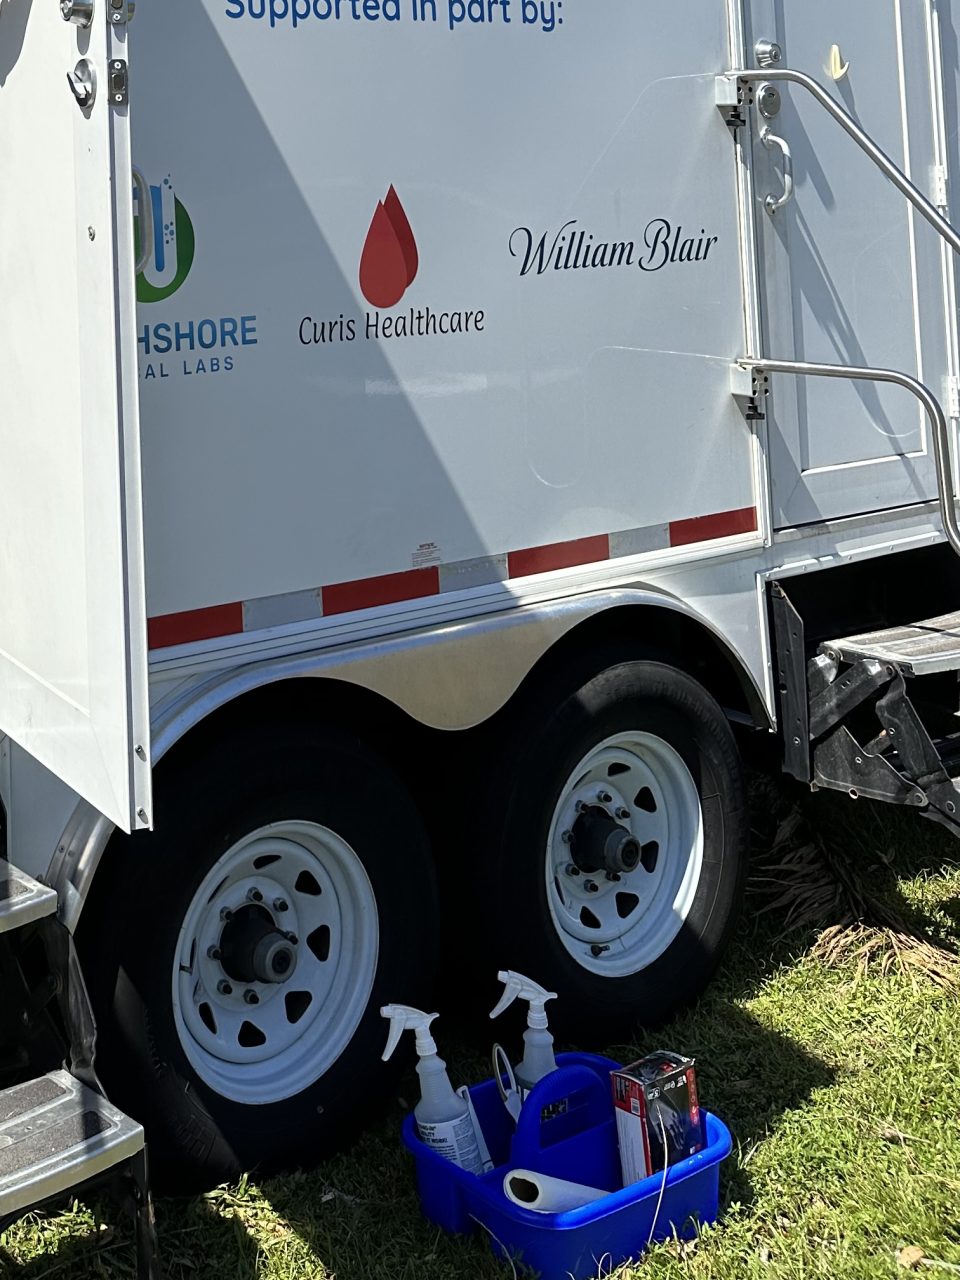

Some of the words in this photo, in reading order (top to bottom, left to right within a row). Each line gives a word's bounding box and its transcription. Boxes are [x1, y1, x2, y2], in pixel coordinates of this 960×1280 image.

[508, 220, 634, 277] William
[638, 218, 719, 272] Blair
[298, 314, 356, 345] Curis
[364, 306, 486, 339] Healthcare
[138, 362, 170, 380] AL
[183, 355, 235, 376] LABS
